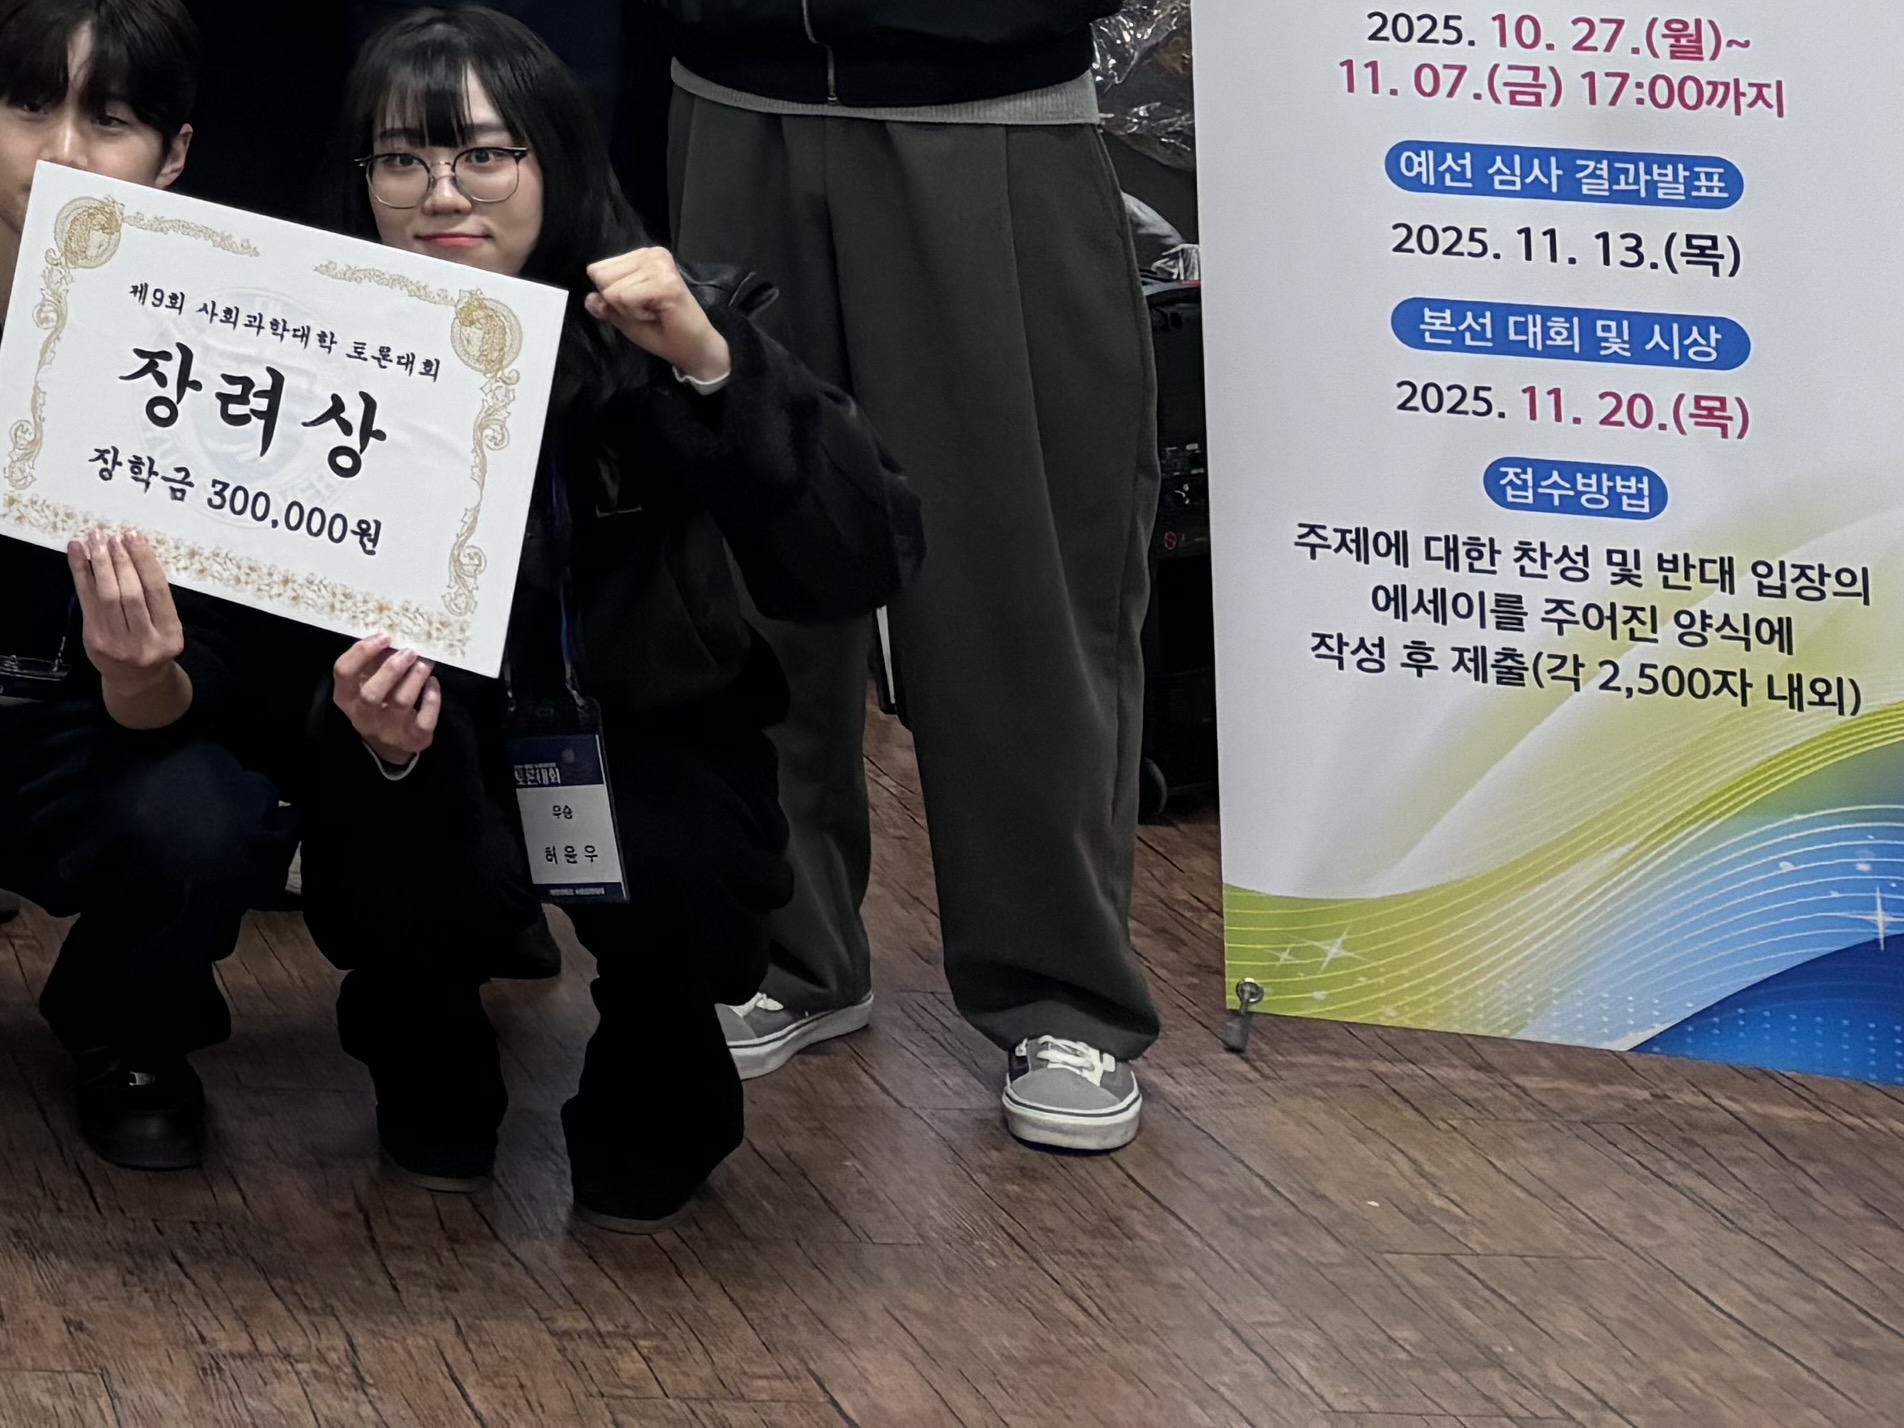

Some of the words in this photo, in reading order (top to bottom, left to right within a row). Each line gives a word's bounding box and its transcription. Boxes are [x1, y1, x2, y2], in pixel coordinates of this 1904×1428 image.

[1368, 12, 1475, 46] 2025.
[1492, 14, 1554, 50] 10.
[1572, 17, 1750, 61] 27.(월)~
[1340, 59, 1398, 96] 11.
[1414, 63, 1562, 107] 07.(금)
[1581, 71, 1783, 118] 17:00까지
[1398, 150, 1472, 190] 예선
[1488, 155, 1562, 192] 심사
[1574, 157, 1730, 205] 결과발표
[1392, 223, 1500, 259] 2025.
[1517, 227, 1576, 264] 11.
[1595, 232, 1740, 277] 13.(목)
[130, 283, 185, 315] 제9회
[196, 301, 337, 354] 사회과학대학
[346, 342, 440, 382] 토론대회
[1420, 308, 1493, 346] 본선
[1509, 314, 1579, 353] 대회
[1597, 320, 1631, 356] 및
[1645, 323, 1721, 361] 시상
[119, 340, 389, 481] 장려상
[1397, 381, 1505, 418] 2025.
[1522, 386, 1581, 424] 11.
[1599, 392, 1749, 439] 20.(목)
[88, 446, 194, 501] 장학금
[207, 479, 381, 555] 300,000원
[1497, 465, 1653, 513] 접수방법
[1294, 523, 1408, 568] 주제에
[1425, 534, 1501, 575] 대한
[1514, 541, 1589, 582] 찬성
[1607, 549, 1643, 587] 및
[1658, 553, 1734, 595] 반대
[1751, 560, 1869, 606] 입장의
[1372, 584, 1528, 632] 에세이를
[1541, 598, 1658, 643] 주어진
[1674, 610, 1793, 655] 양식에
[1311, 633, 1385, 673] 작성
[1401, 640, 1438, 677] 후
[1451, 646, 1585, 692] 제출(각
[1599, 660, 1753, 707] 2,500자
[1768, 673, 1861, 716] 내외)
